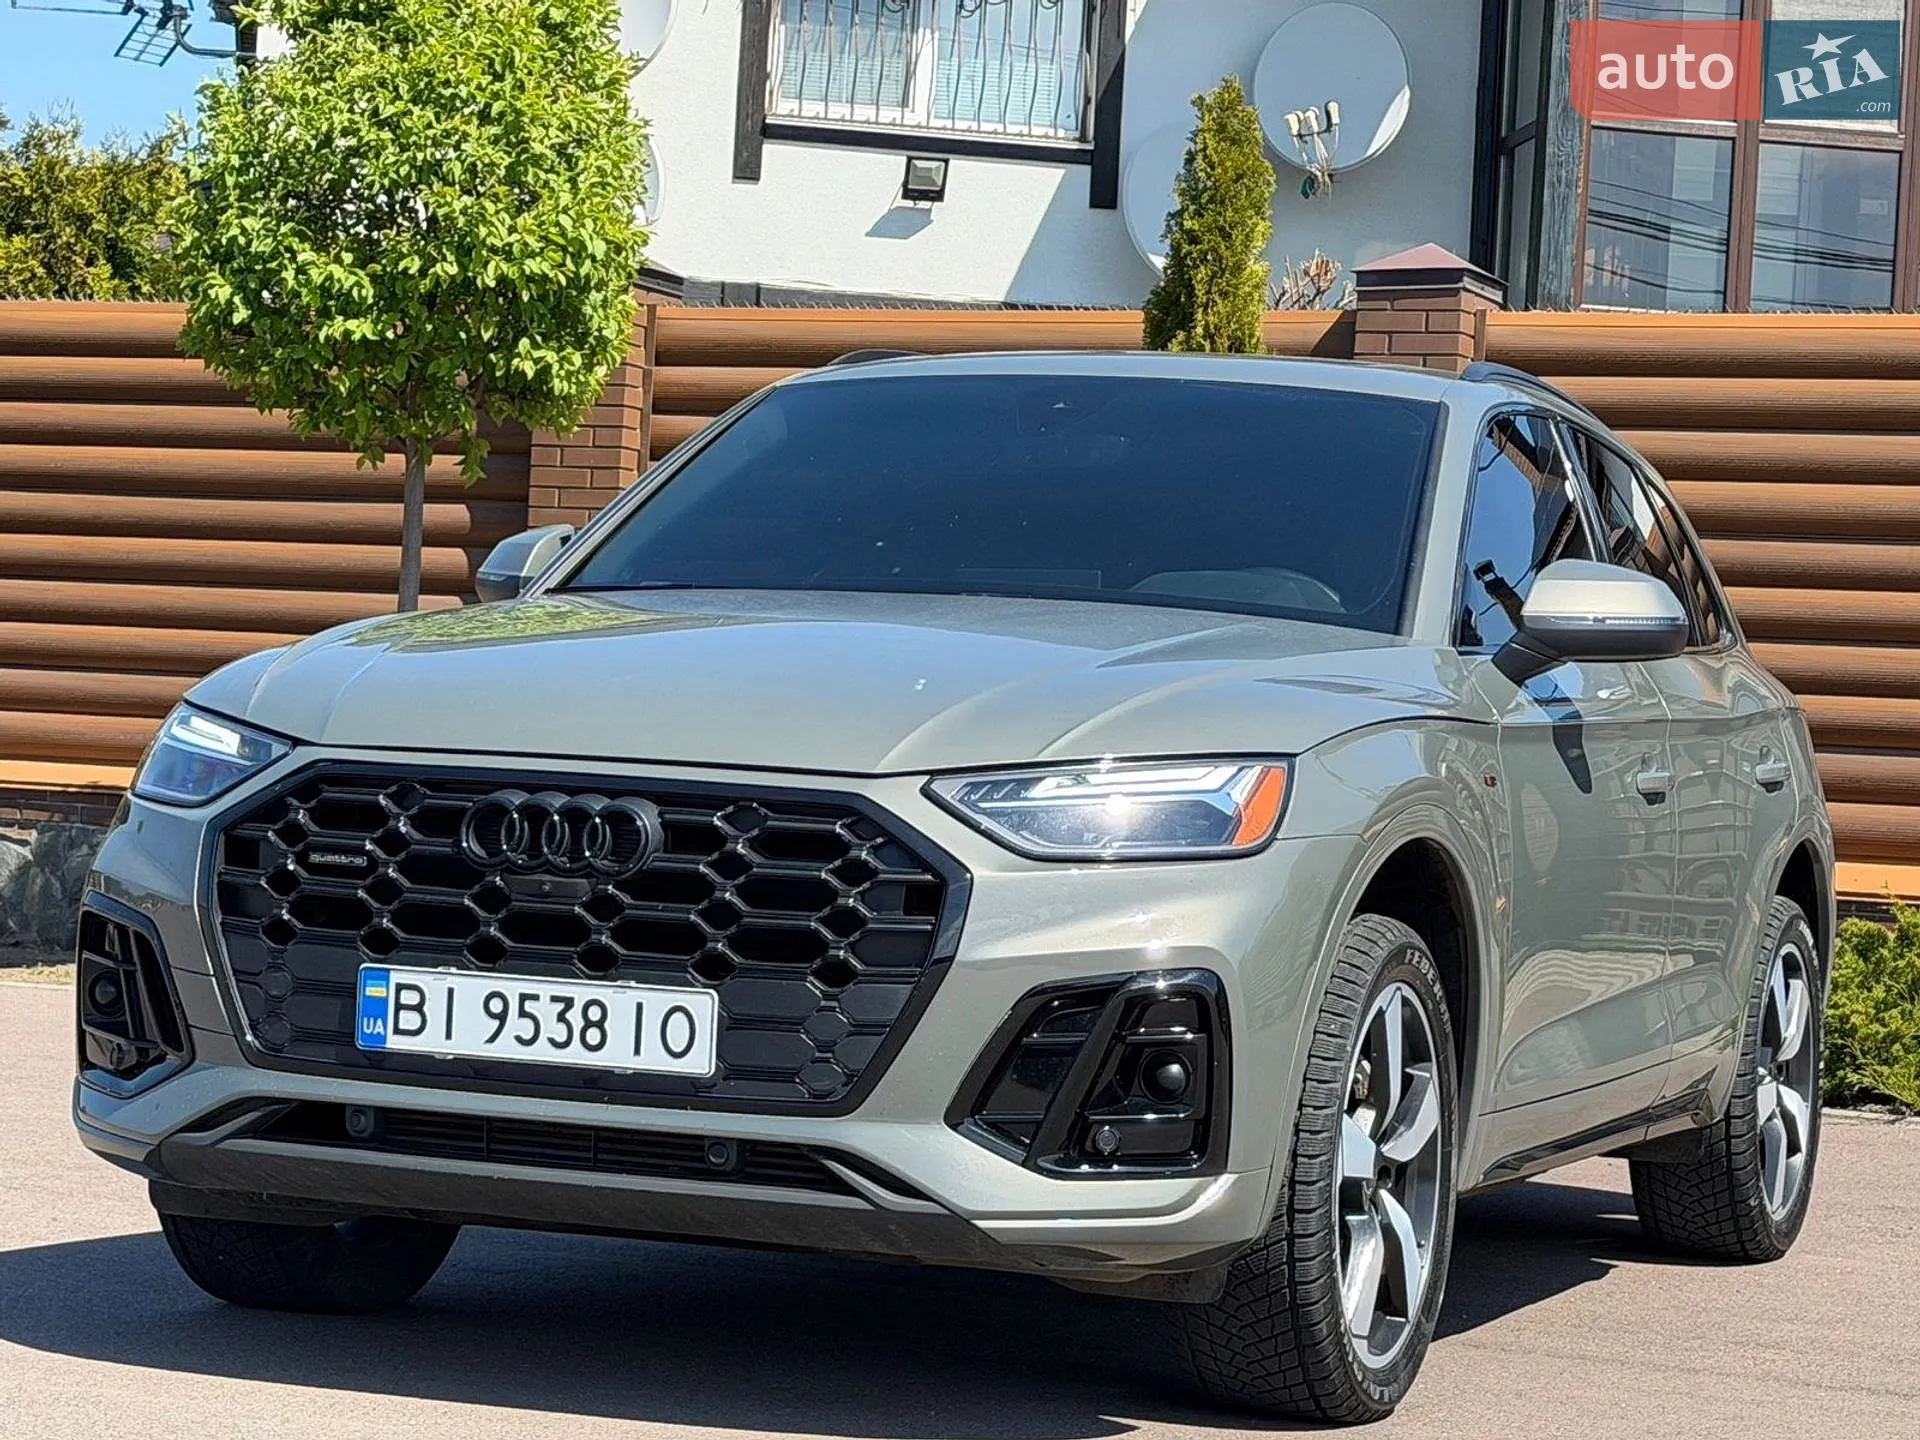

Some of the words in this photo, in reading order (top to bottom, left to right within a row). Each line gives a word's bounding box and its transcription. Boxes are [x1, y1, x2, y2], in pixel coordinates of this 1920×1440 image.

[363, 1016, 385, 1036] UA
[392, 982, 455, 1041] BI
[482, 990, 609, 1051] 9538
[633, 1001, 697, 1060] IO
